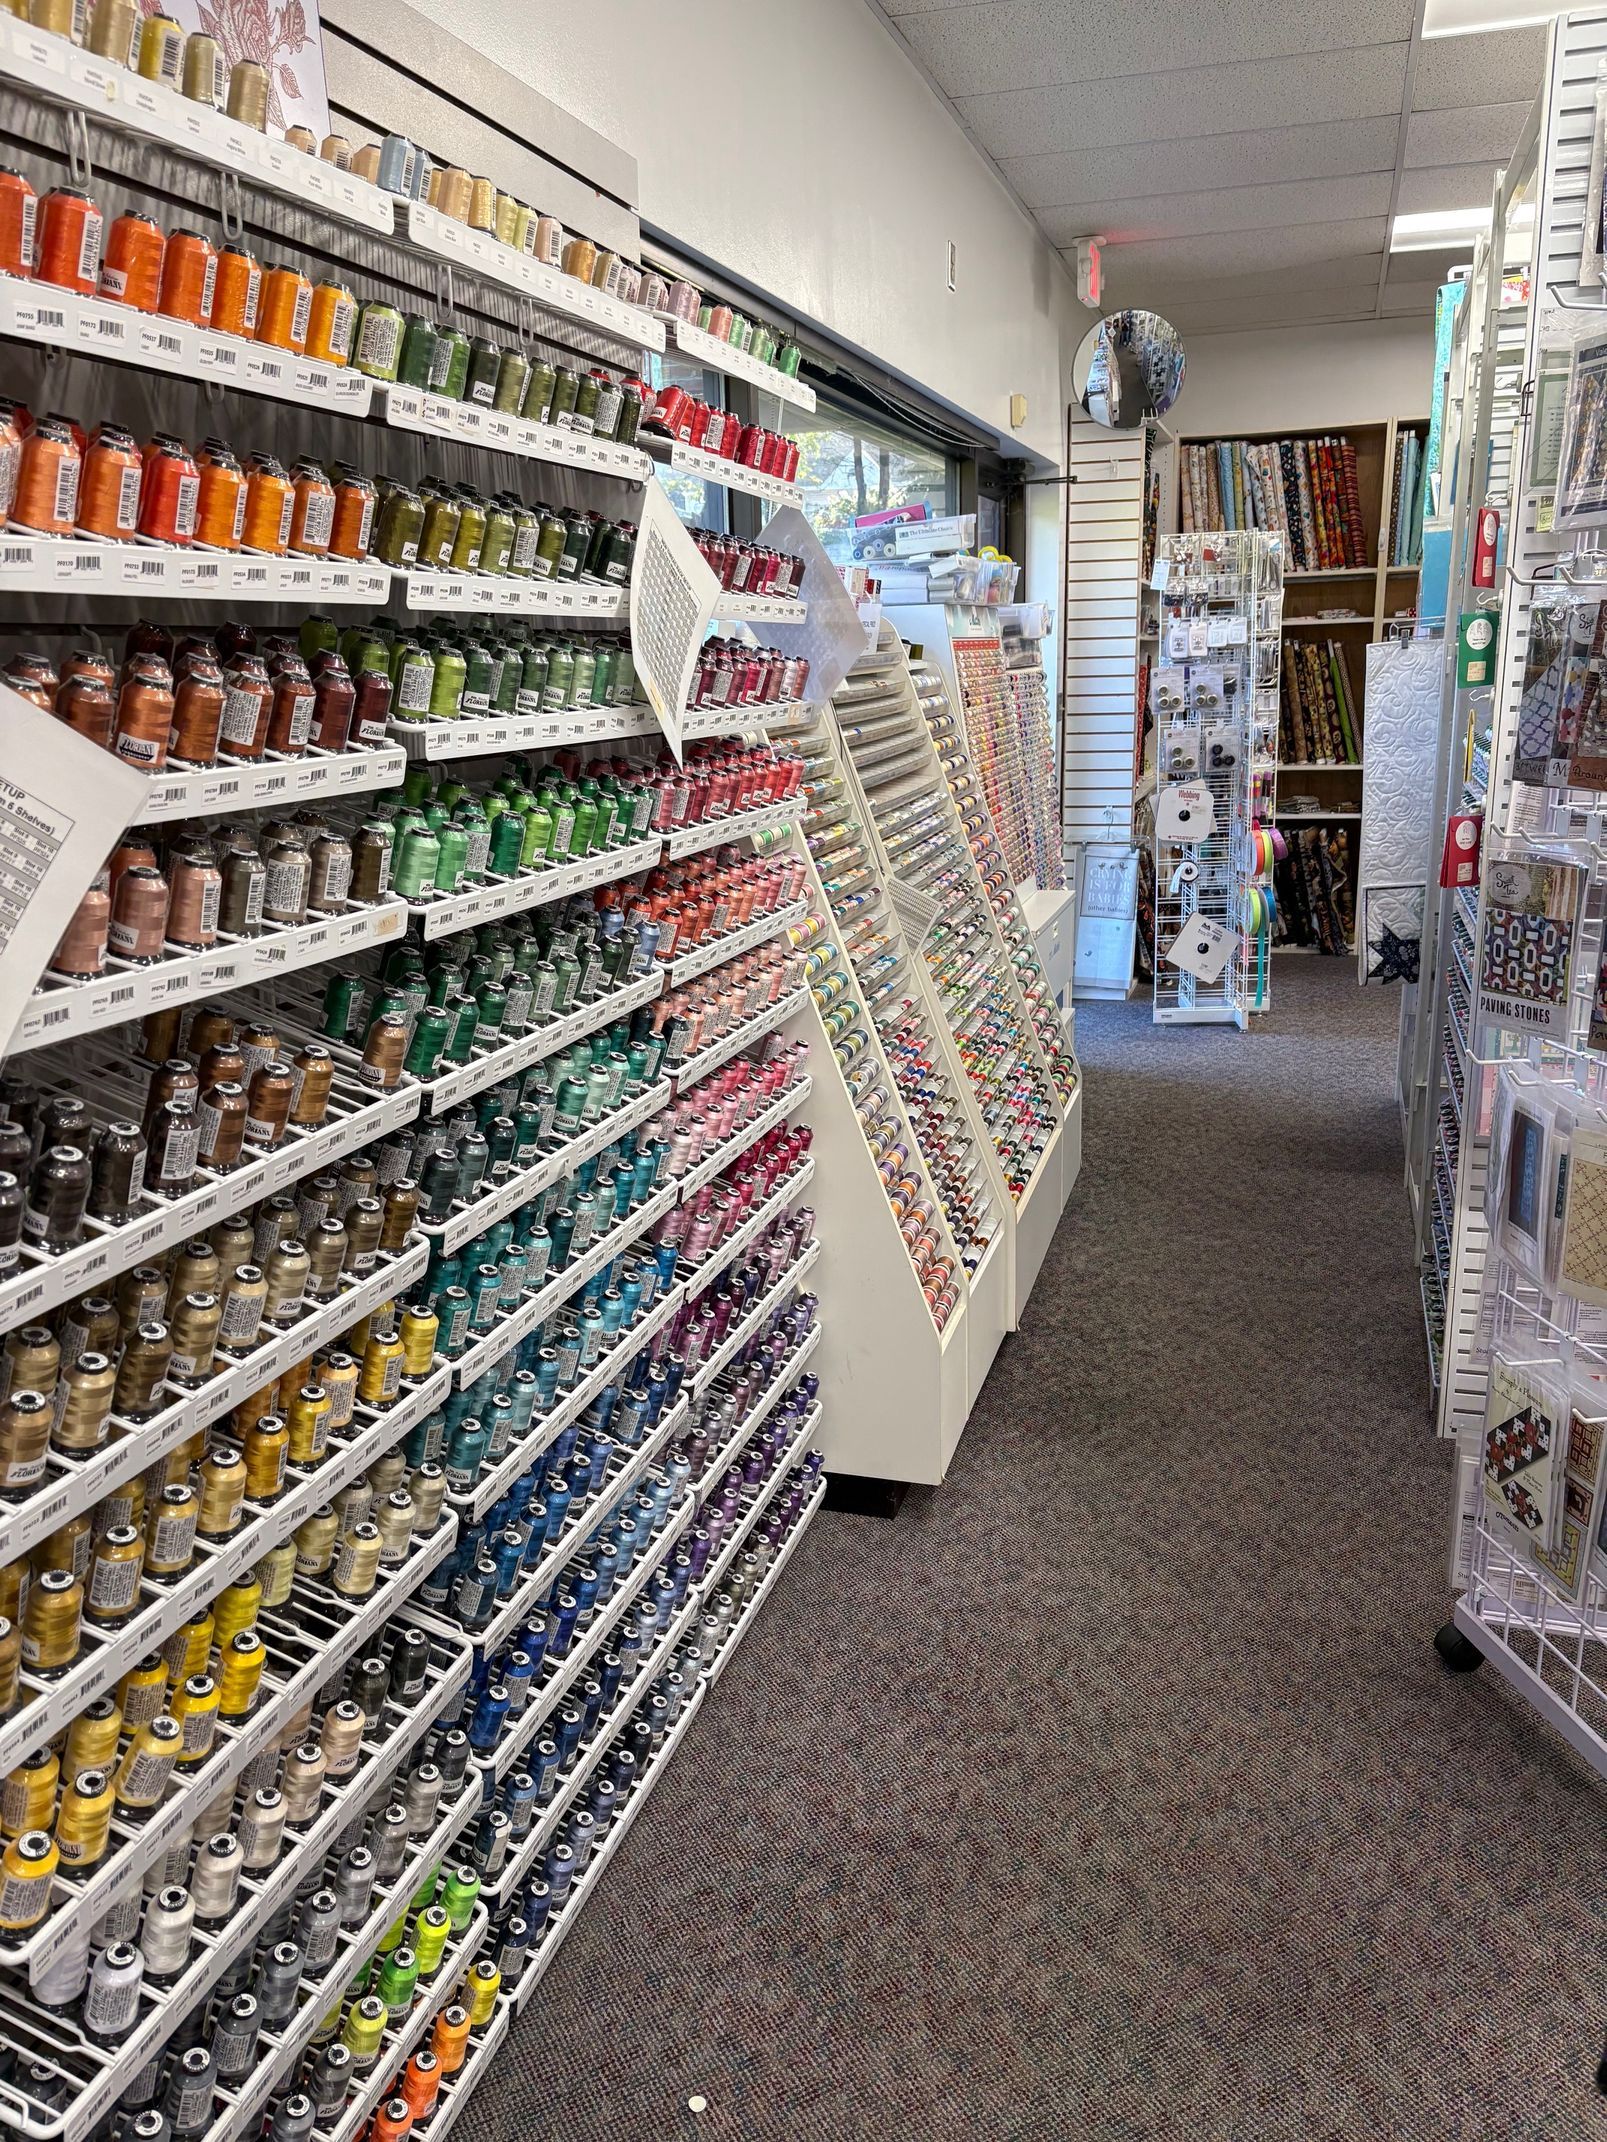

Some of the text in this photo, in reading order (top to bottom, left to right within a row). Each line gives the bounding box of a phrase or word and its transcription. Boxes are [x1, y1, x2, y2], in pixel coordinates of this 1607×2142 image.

[15, 806, 56, 836] Shelves)
[1090, 868, 1131, 880] CRYING
[1090, 879, 1130, 893] IS FOR
[1503, 884, 1519, 896] Tea
[1088, 892, 1130, 906] BABIES
[1481, 996, 1551, 1025] PAVING STONES
